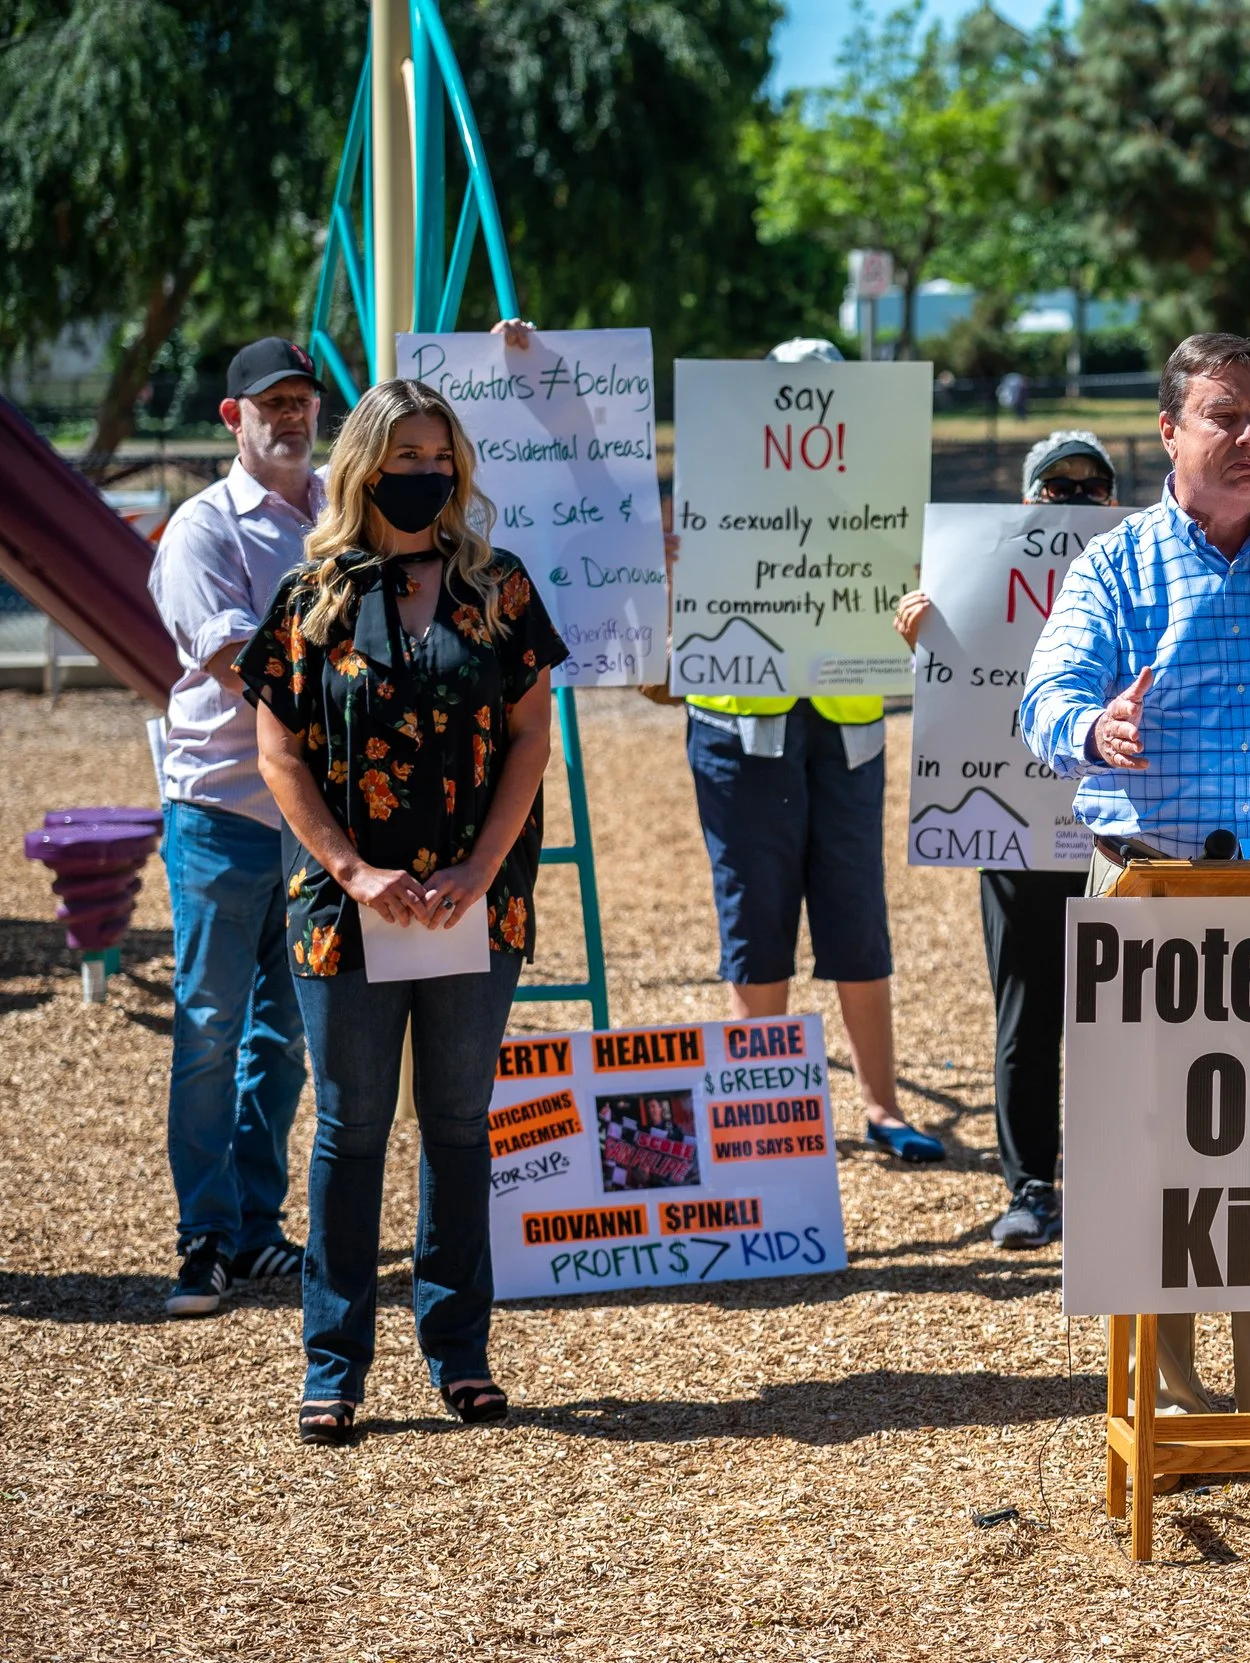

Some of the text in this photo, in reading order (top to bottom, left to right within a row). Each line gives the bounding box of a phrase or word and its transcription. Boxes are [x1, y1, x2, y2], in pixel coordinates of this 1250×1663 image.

[412, 344, 534, 400] Predators
[574, 360, 652, 411] belong
[774, 383, 834, 426] say
[477, 422, 652, 462] residential areas!
[764, 423, 847, 472] NO!
[504, 505, 534, 528] us
[681, 501, 910, 547] to sexually violent
[549, 567, 572, 586] @
[757, 554, 873, 589] predators
[675, 591, 698, 614] in
[707, 590, 826, 626] community
[680, 652, 786, 692] GMIA
[924, 652, 951, 683] to
[917, 755, 1010, 778] in our
[915, 829, 1029, 869] GMIA
[1055, 841, 1088, 850] Sexually
[498, 1024, 803, 1077] ERTY HEALTH CARE
[713, 1100, 821, 1129] LANDLORD
[715, 1135, 826, 1160] WHO SAYS YES
[490, 1170, 521, 1190] FOR
[524, 1209, 643, 1244] GIOVANNI
[740, 1226, 827, 1266] KIDS
